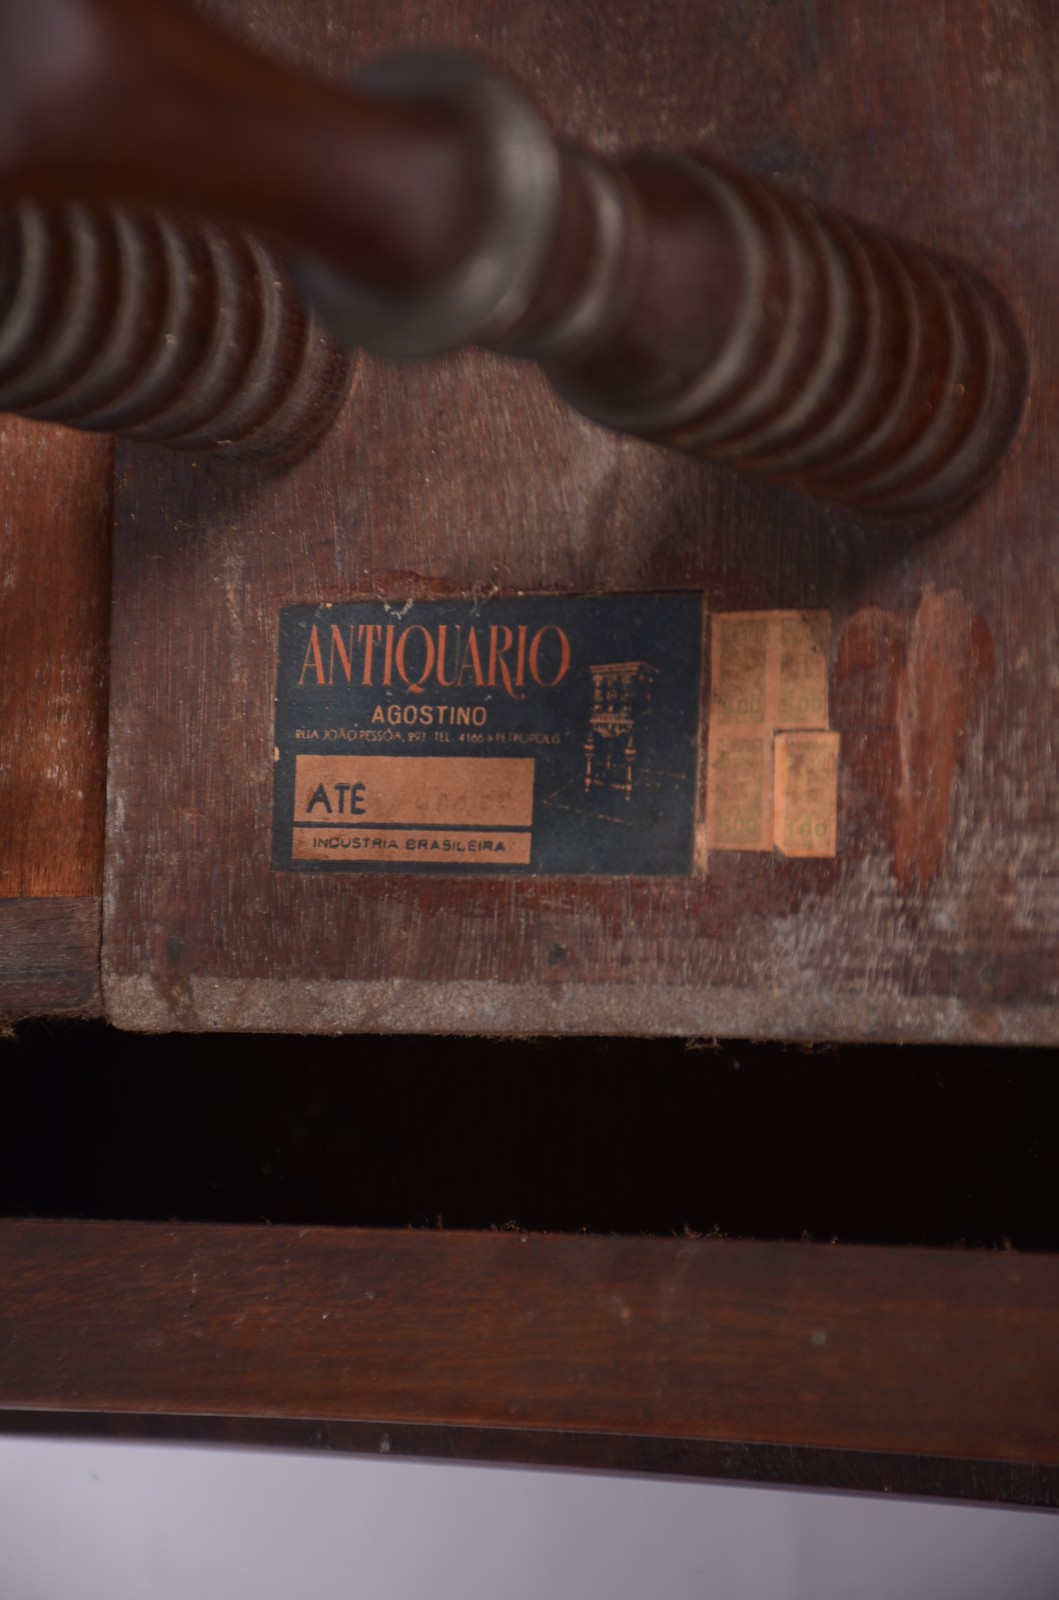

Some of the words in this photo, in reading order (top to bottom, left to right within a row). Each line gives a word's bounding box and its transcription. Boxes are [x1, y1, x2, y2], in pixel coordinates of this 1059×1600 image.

[297, 623, 572, 700] ANTIQUARIO
[371, 704, 488, 726] AGOSTINO
[295, 729, 319, 739] RUA
[405, 838, 506, 852] BRASILEIRA
